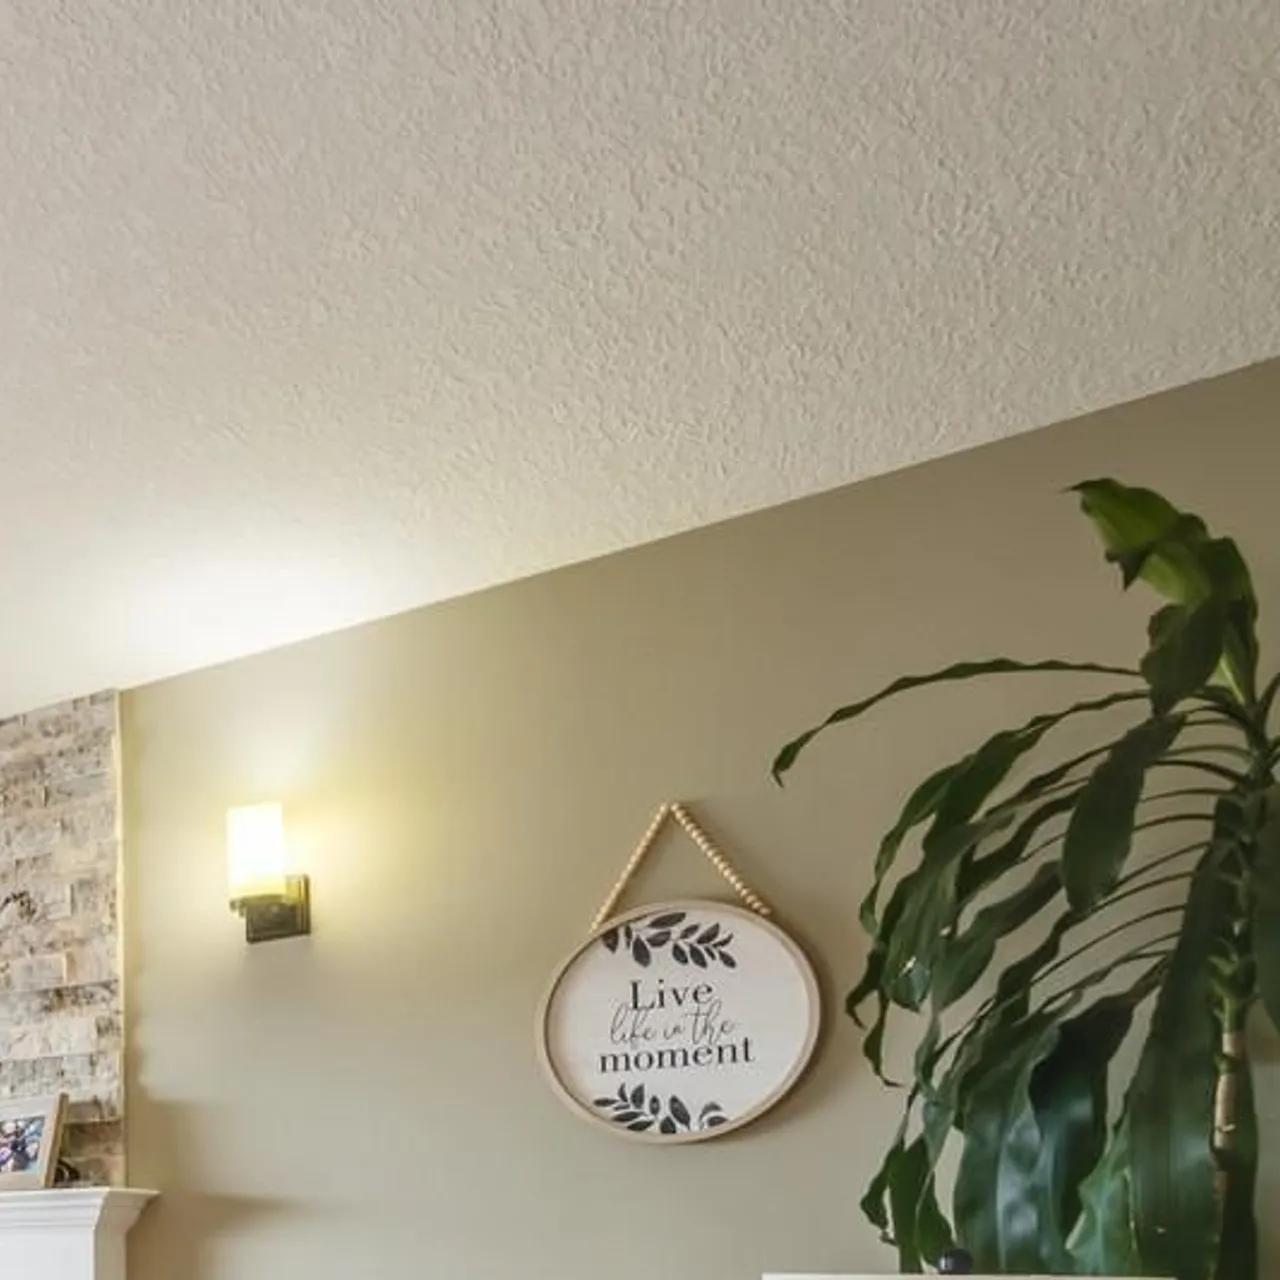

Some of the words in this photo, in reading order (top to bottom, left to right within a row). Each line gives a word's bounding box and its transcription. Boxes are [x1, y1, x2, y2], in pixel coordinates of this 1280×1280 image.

[630, 978, 713, 1010] Live
[684, 998, 736, 1046] the
[598, 1036, 755, 1073] moment
